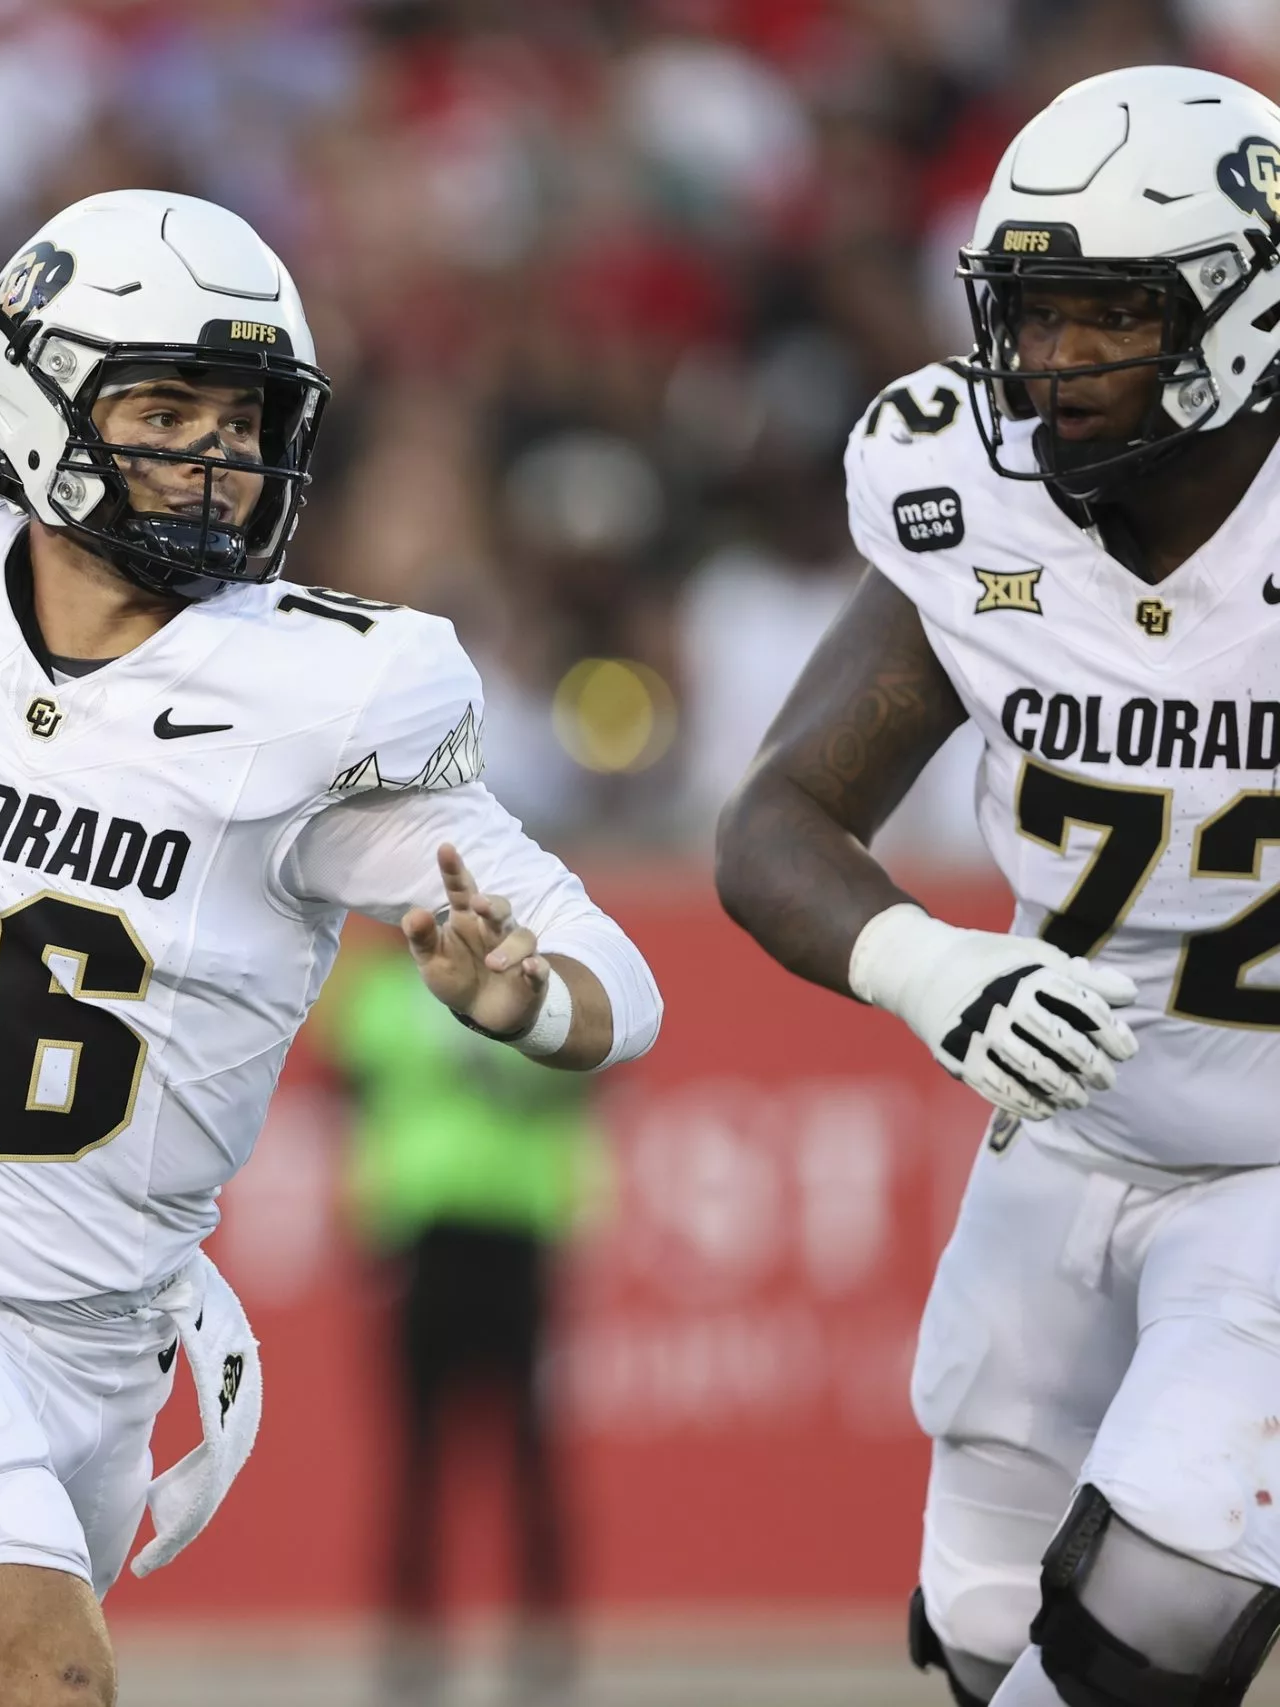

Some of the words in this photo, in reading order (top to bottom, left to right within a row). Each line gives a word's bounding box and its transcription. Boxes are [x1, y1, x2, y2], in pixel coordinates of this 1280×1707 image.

[1003, 229, 1051, 252] BUFFS
[230, 320, 276, 344] BUFFS
[896, 498, 957, 525] mac
[909, 519, 954, 541] 82-94
[972, 566, 1044, 616] XII
[1136, 600, 1172, 636] CU
[26, 697, 62, 738] CU
[1002, 687, 1280, 770] COLORAD
[1014, 754, 1280, 1032] 72
